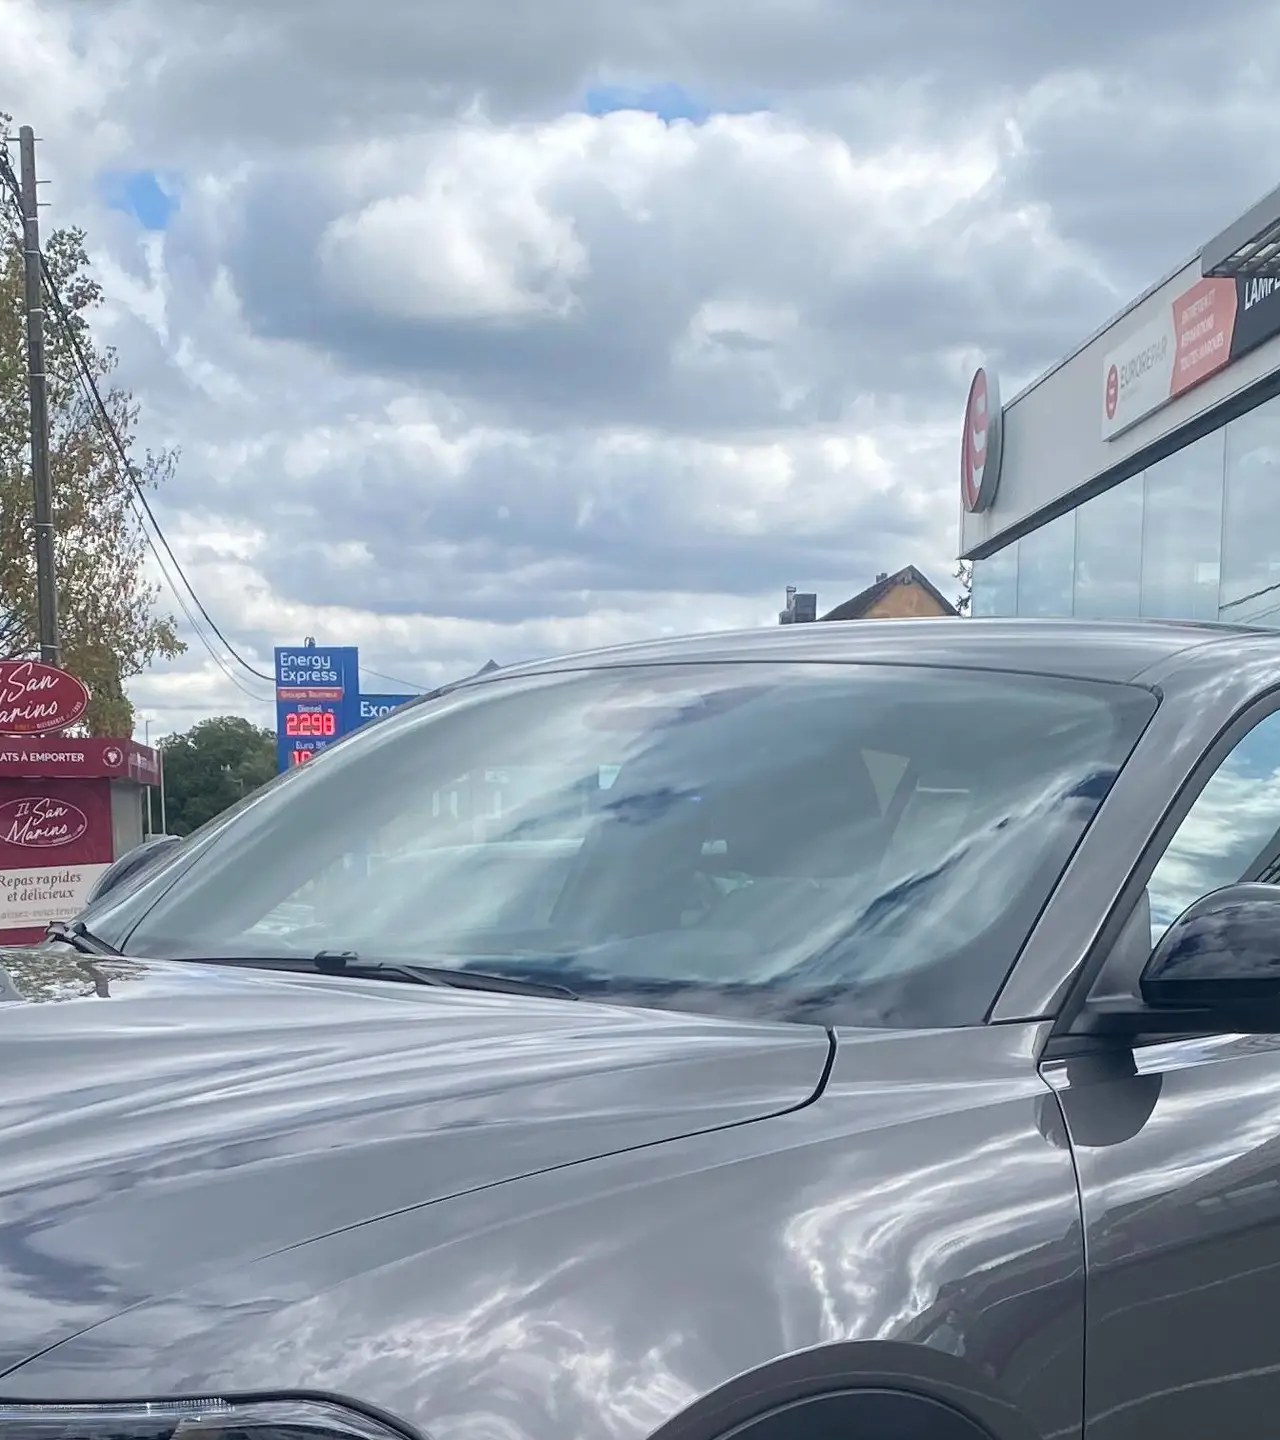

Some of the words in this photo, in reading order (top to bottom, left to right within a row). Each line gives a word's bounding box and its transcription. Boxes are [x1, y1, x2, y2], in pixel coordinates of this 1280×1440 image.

[280, 652, 331, 670] Energy
[7, 661, 60, 703] San
[280, 668, 338, 685] Express
[296, 741, 314, 750] Euro
[21, 750, 29, 762] À
[30, 752, 85, 763] EMPORTER
[32, 798, 69, 826] San
[4, 816, 68, 844] Marino
[36, 871, 82, 889] rapides
[7, 891, 17, 902] et
[20, 887, 75, 902] délicieux
